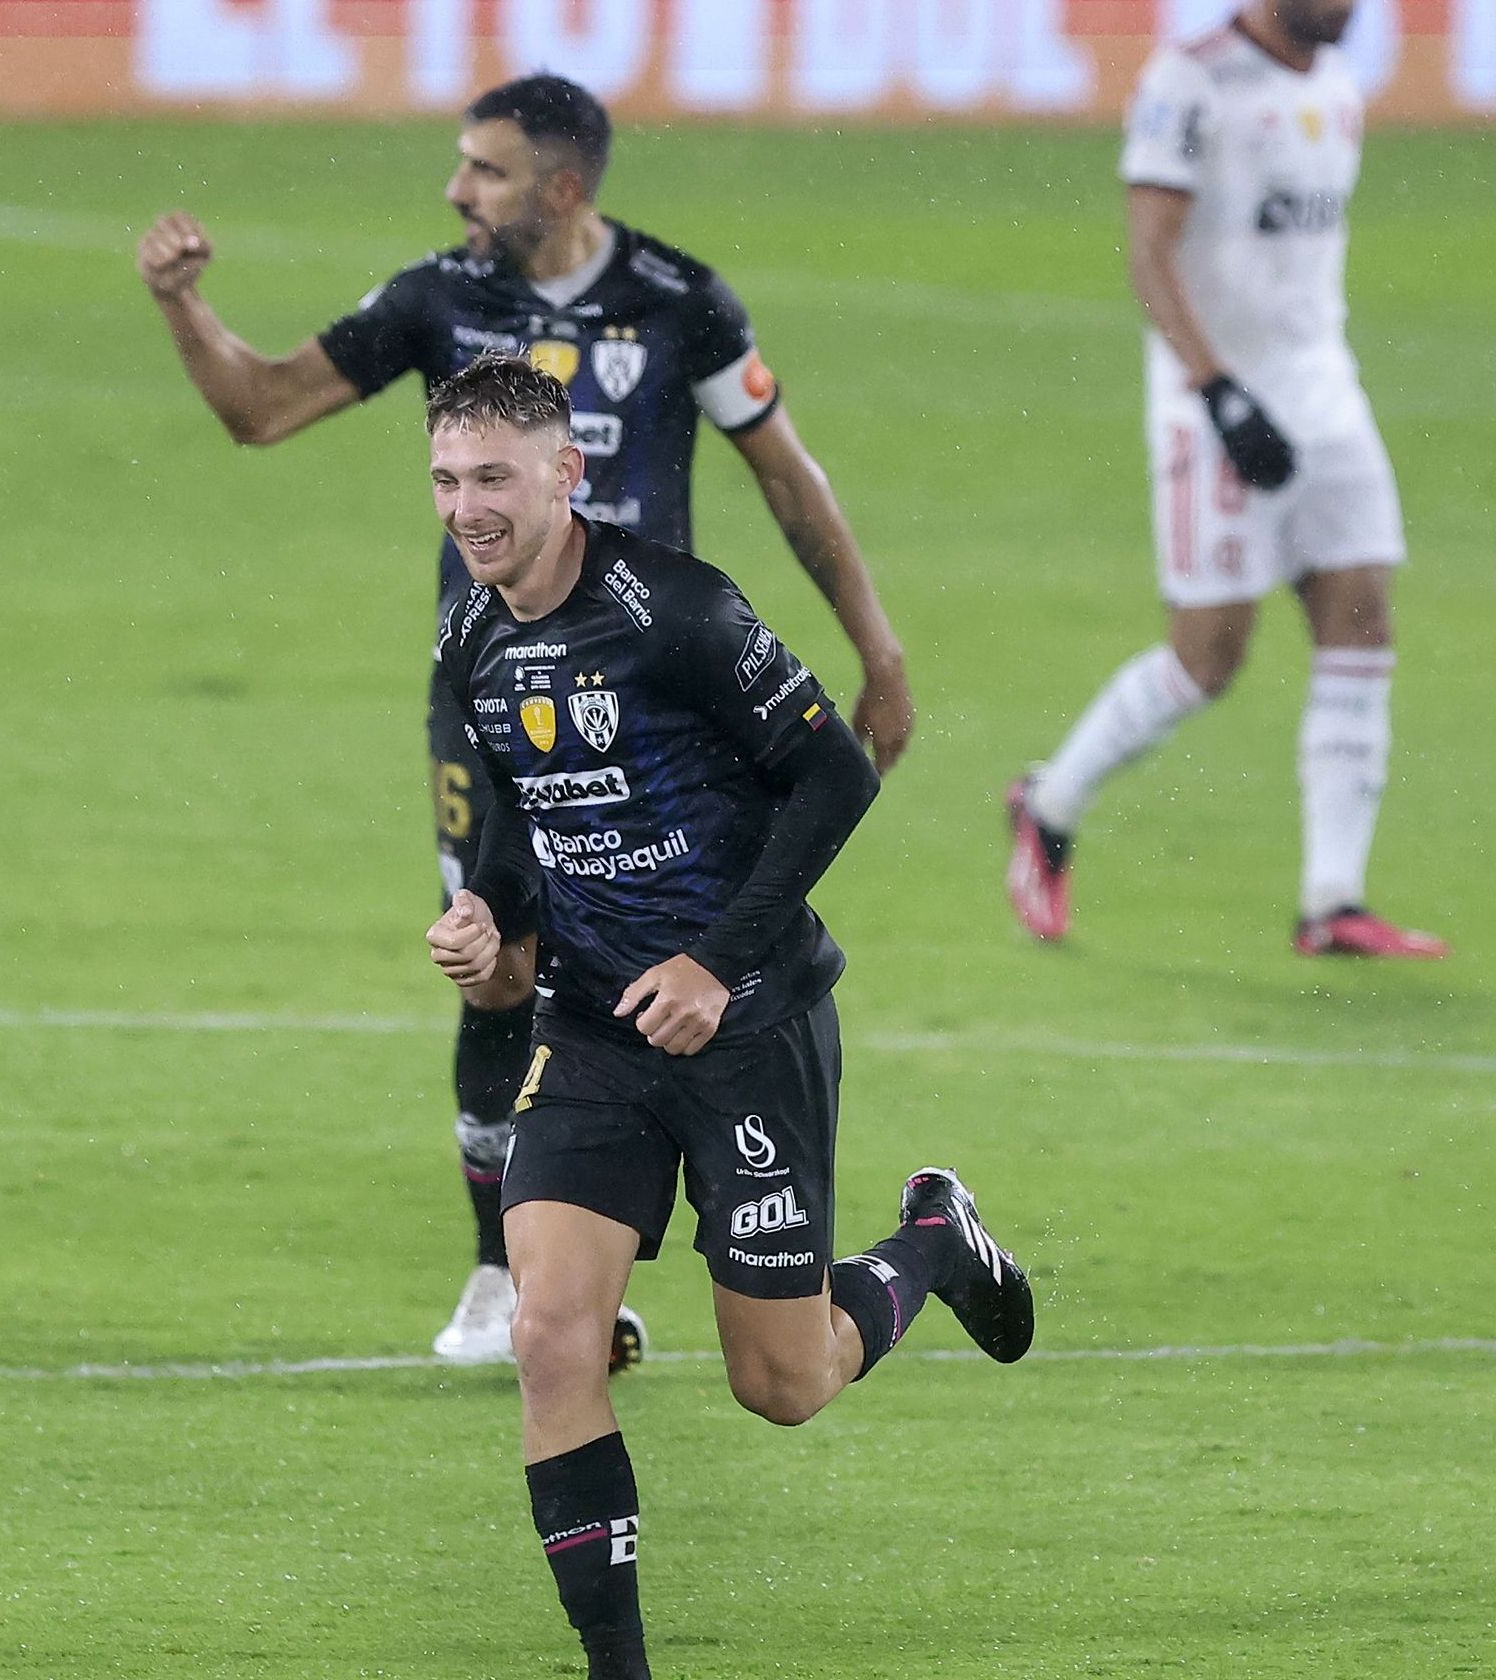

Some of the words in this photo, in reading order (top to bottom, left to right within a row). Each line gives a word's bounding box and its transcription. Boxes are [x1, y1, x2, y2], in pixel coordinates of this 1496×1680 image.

[604, 571, 628, 597] del
[621, 588, 654, 628] Barrio
[612, 558, 651, 601] Banco
[504, 641, 568, 660] marathon
[549, 828, 624, 854] Banco
[556, 828, 691, 881] Guayaquil
[731, 1186, 809, 1239] GOL
[728, 1246, 815, 1269] marathon
